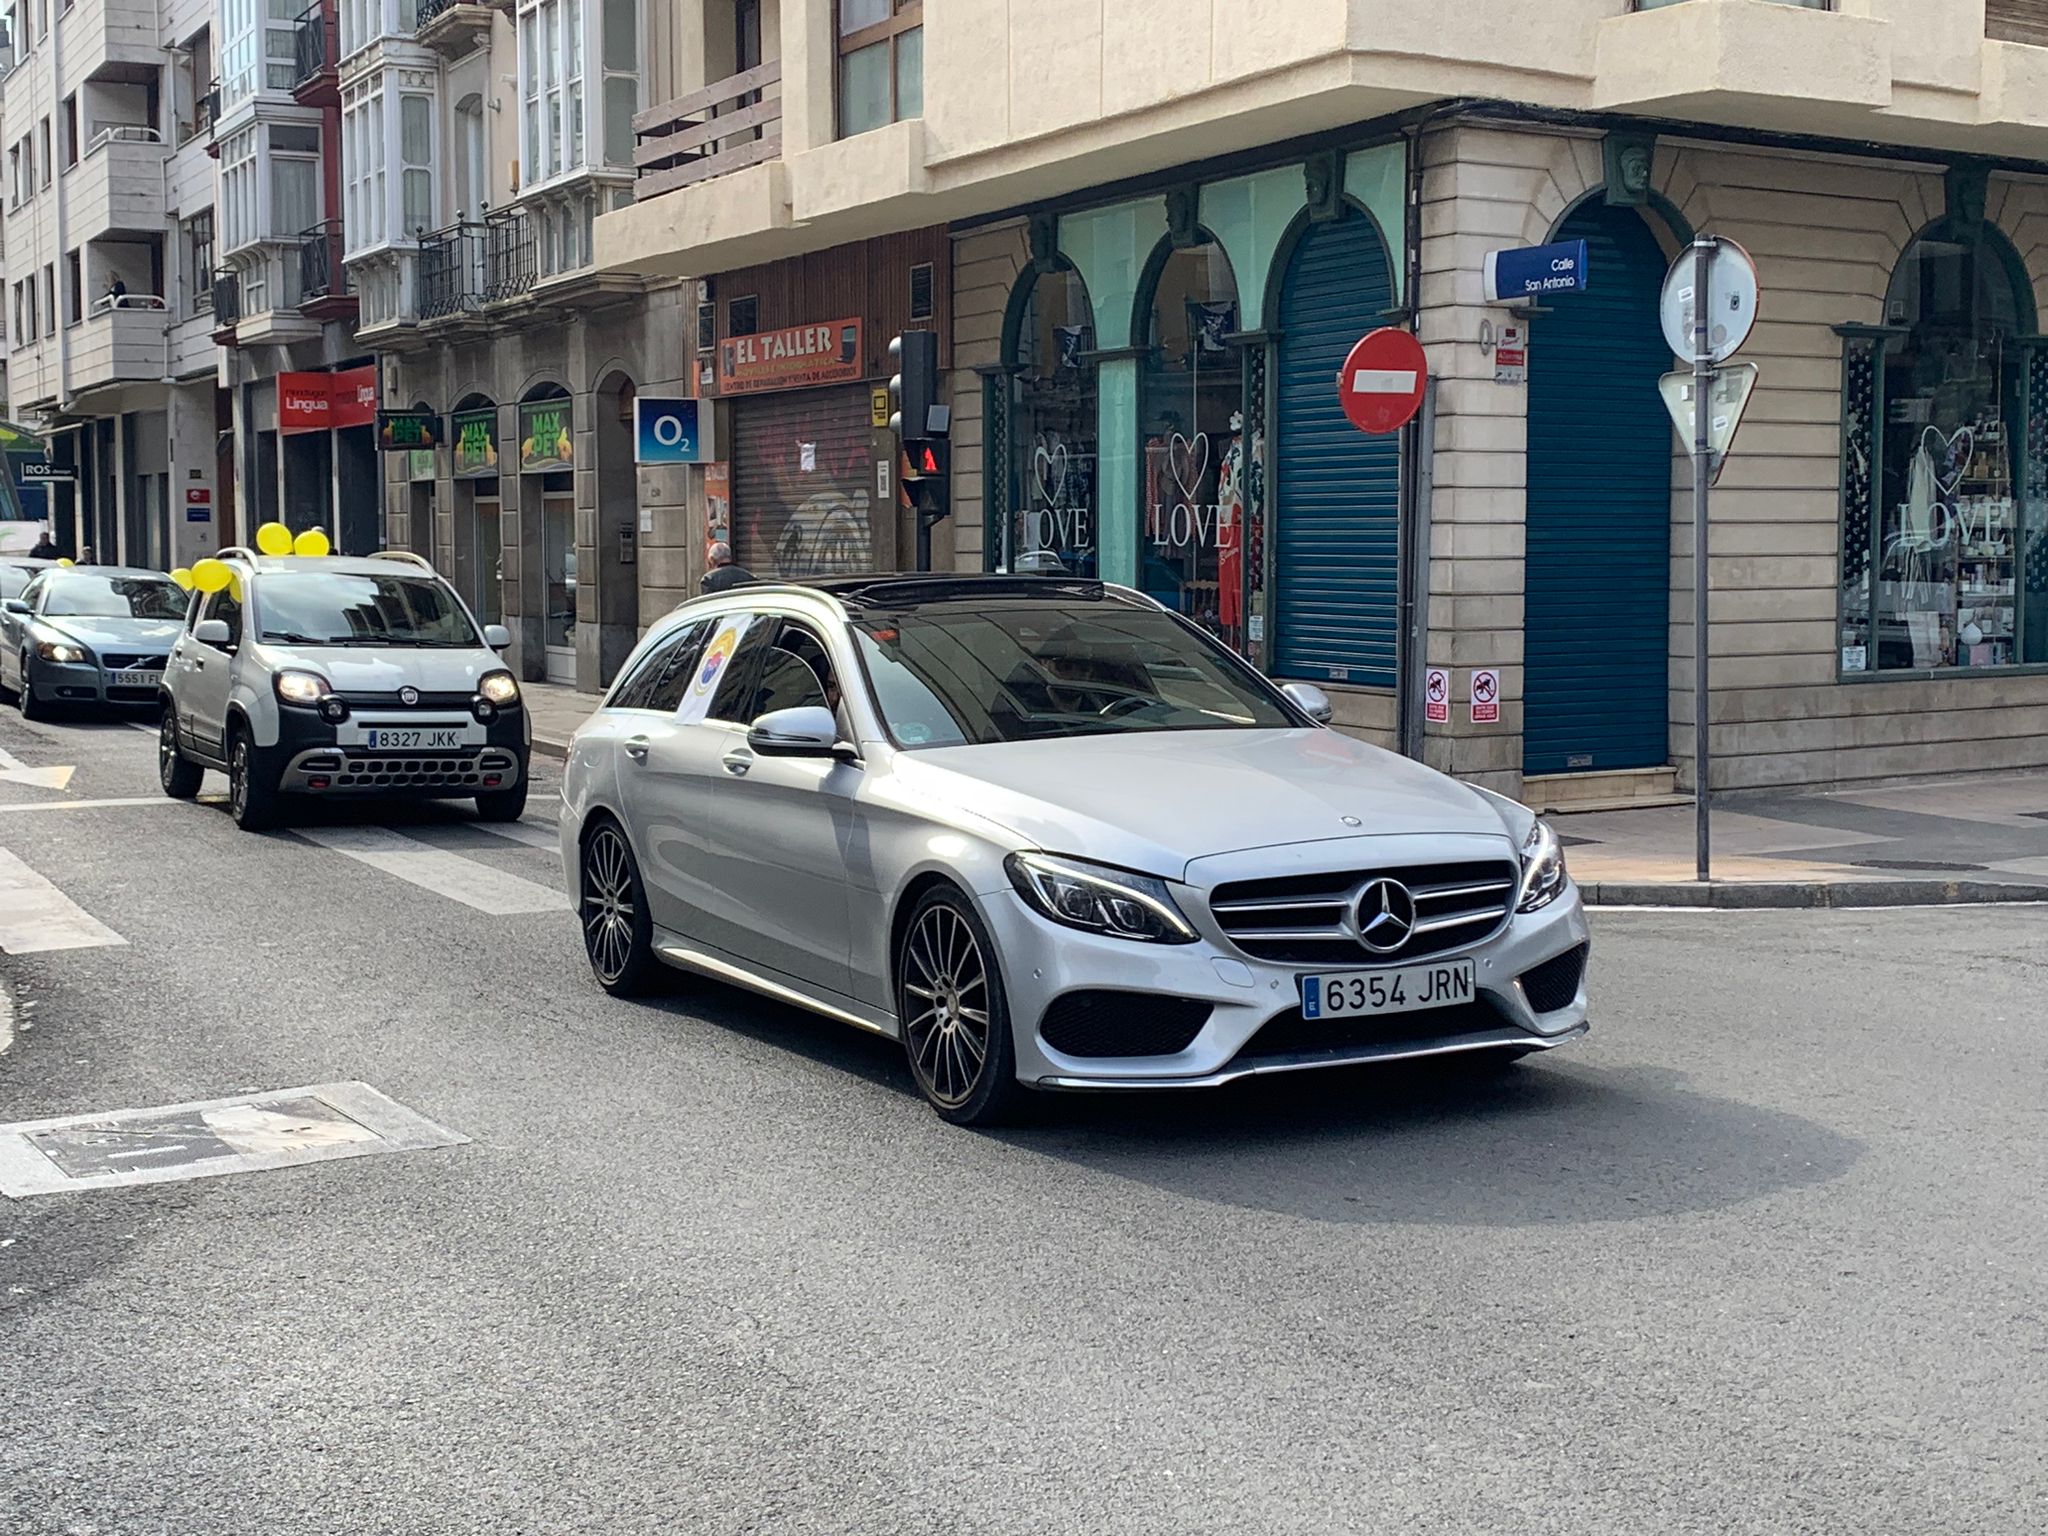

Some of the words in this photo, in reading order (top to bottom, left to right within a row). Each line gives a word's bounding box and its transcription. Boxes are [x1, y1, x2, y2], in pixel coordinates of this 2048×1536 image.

[1551, 258, 1575, 272] Calle
[1525, 279, 1542, 291] San
[1543, 275, 1575, 290] Antonio
[736, 339, 757, 364] EL
[761, 326, 833, 361] TALLER
[286, 396, 328, 413] Lingua
[393, 417, 421, 429] MAX
[464, 421, 487, 442] MAX
[532, 412, 560, 433] MAX
[394, 430, 421, 443] PET
[533, 432, 560, 457] PET
[465, 441, 487, 464] PET
[25, 464, 51, 475] ROS
[1021, 508, 1090, 549] LOVE
[1153, 503, 1232, 548] LOVE
[1897, 502, 2010, 548] LOVE
[117, 673, 145, 684] 5551
[148, 674, 161, 685] FL
[379, 732, 421, 747] 8327
[427, 731, 457, 747] JKK
[1326, 974, 1407, 1012] 6354
[1418, 966, 1469, 1002] JRN
